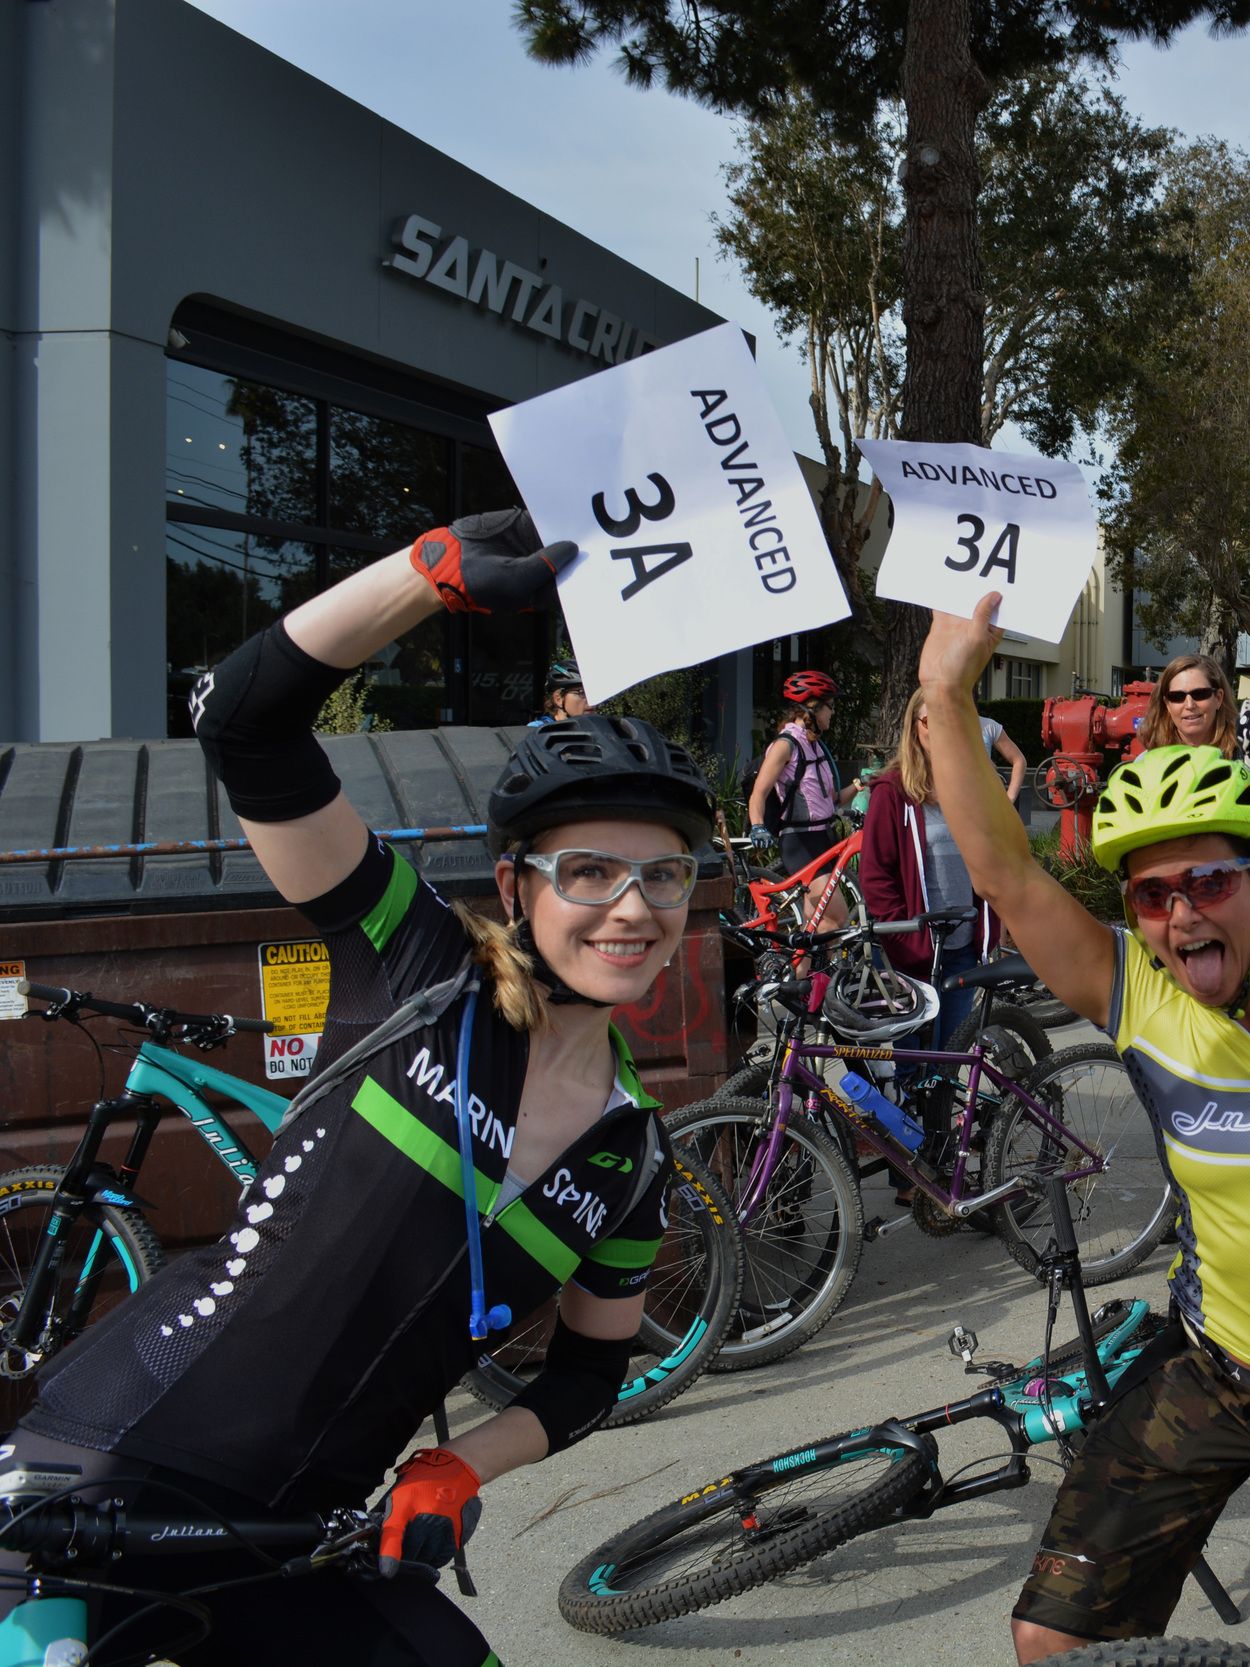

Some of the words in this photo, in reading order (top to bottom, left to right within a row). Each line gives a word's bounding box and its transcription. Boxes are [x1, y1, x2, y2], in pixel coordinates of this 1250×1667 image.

[392, 214, 562, 341] SANTA
[568, 299, 664, 365] CRU
[690, 389, 797, 594] ADVANCED
[902, 461, 1057, 499] ADVANCED
[592, 472, 693, 602] 3A
[944, 514, 1020, 584] 3A
[267, 943, 329, 964] CAUTION
[299, 1013, 311, 1021] FILL
[270, 1037, 304, 1057] NO
[832, 1046, 893, 1060] SPECIALIZED
[270, 1060, 285, 1074] DO
[291, 1057, 313, 1071] NOT
[407, 1047, 515, 1159] MARIN
[772, 1448, 817, 1473] ROCKSHOX
[34, 1474, 71, 1482] GARMIN
[151, 1525, 228, 1541] Juliana
